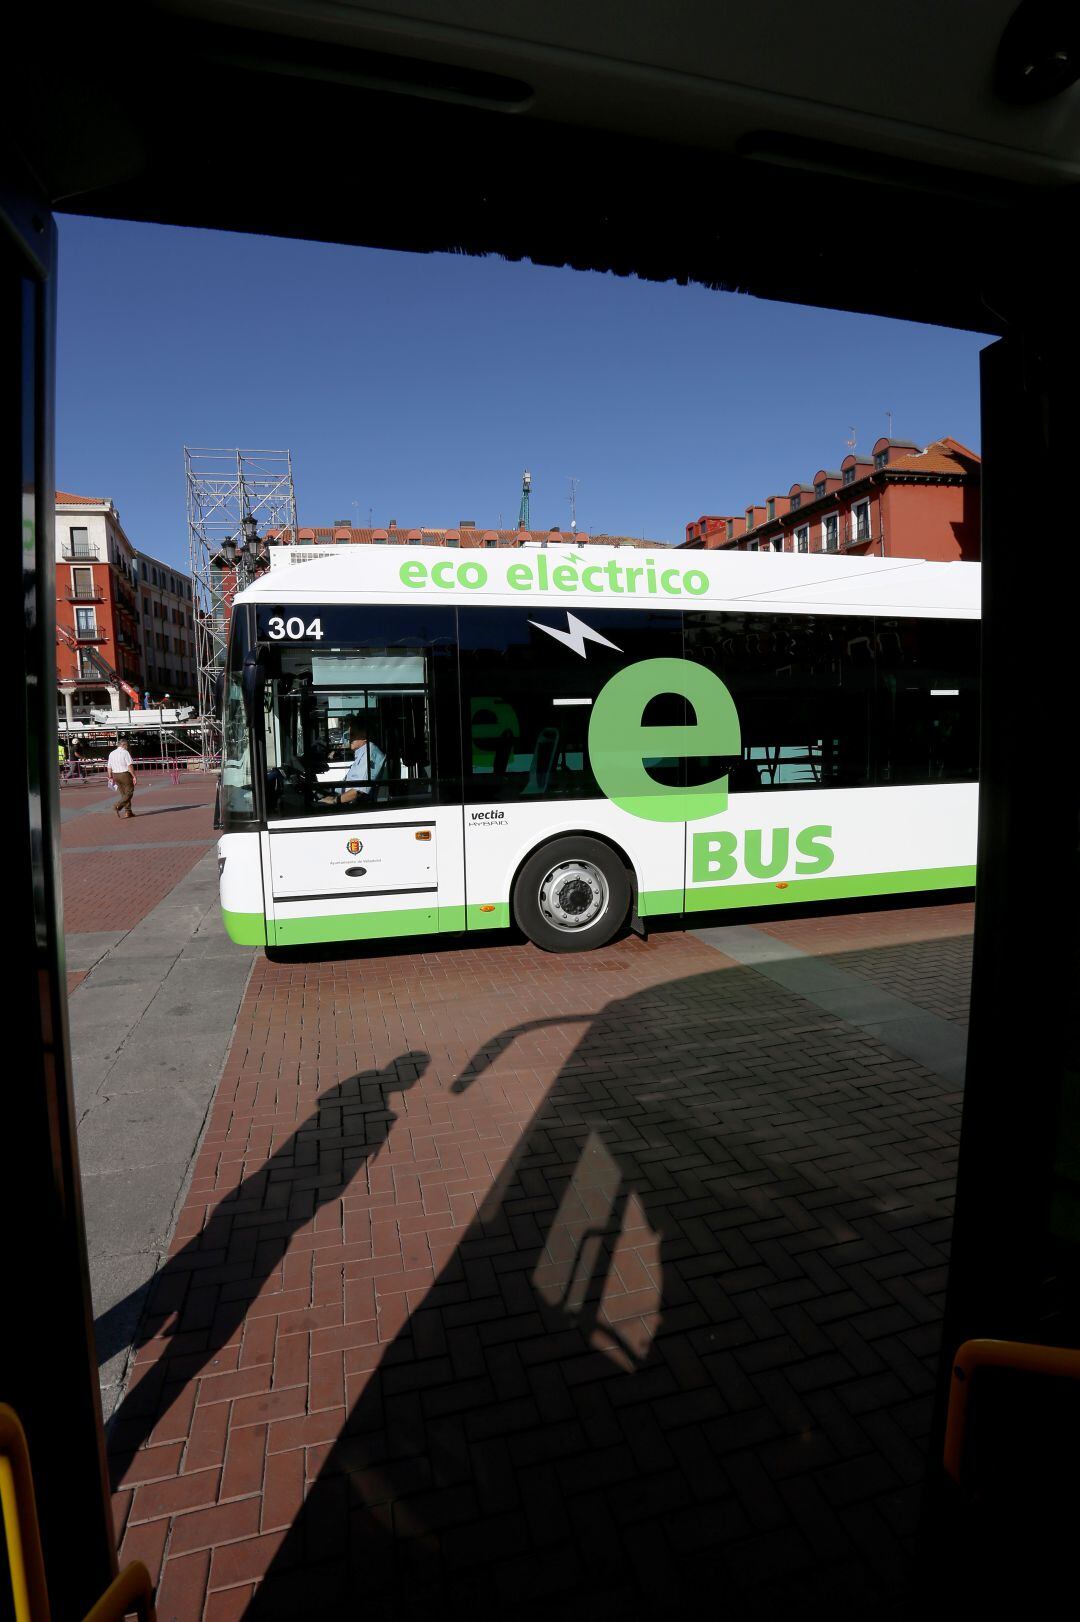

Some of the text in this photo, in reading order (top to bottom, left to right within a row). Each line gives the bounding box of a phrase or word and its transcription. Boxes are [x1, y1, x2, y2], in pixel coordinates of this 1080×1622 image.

[399, 560, 488, 590] eco
[268, 617, 324, 641] 304
[588, 657, 742, 823] e
[471, 809, 505, 820] vectia
[692, 825, 835, 883] BUS
